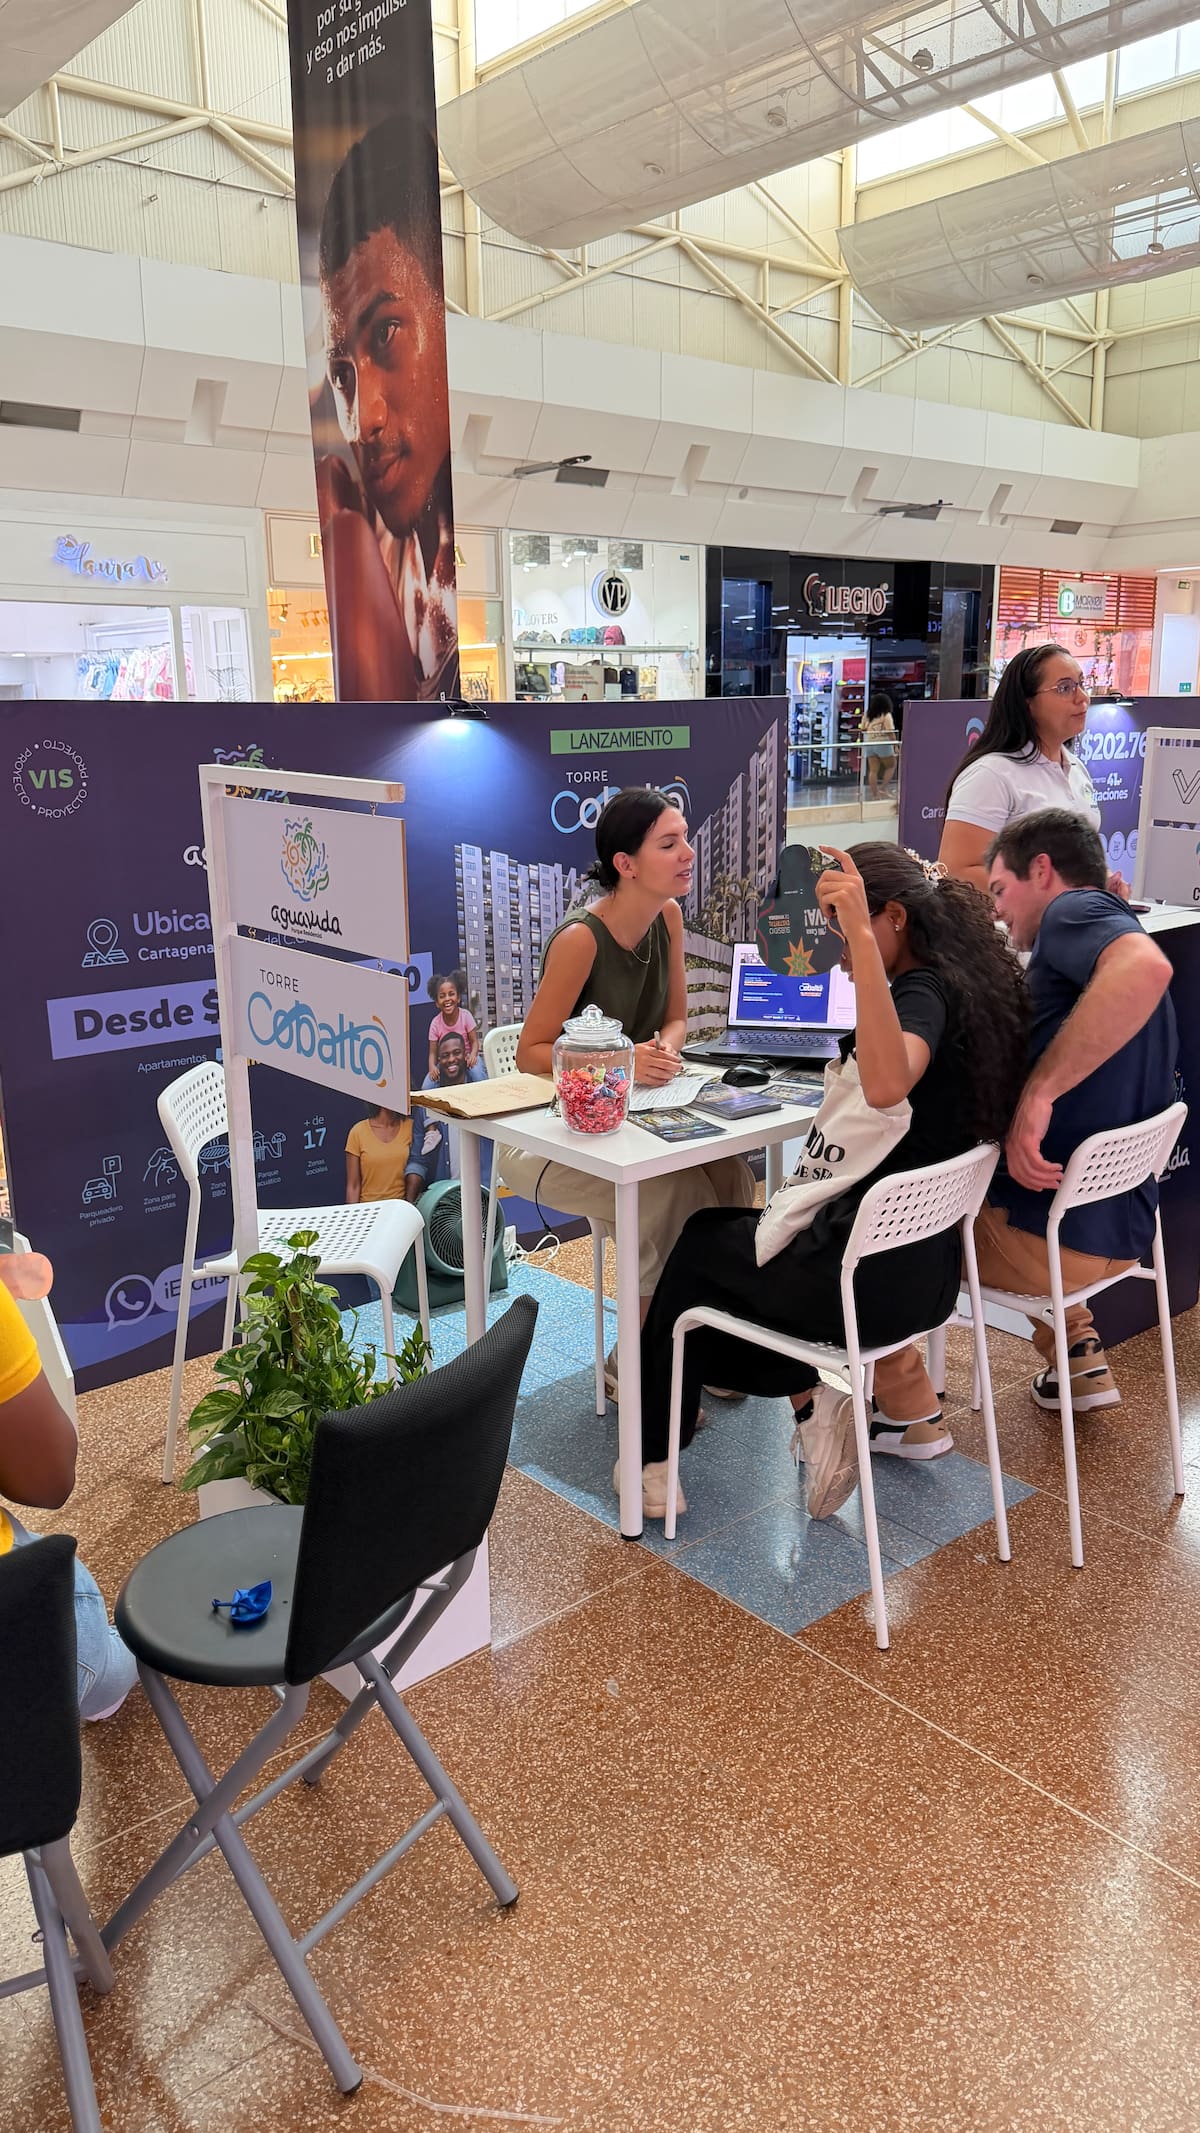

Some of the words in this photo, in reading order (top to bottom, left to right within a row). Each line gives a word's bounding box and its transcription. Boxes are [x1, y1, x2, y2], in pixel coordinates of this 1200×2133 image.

[317, 4, 336, 36] por
[306, 50, 313, 74] y
[314, 37, 334, 62] eso
[336, 21, 357, 49] nos
[326, 66, 334, 83] a
[336, 52, 355, 78] dar
[357, 34, 386, 65] más.
[605, 582, 627, 611] VP
[826, 585, 887, 616] LEGIO
[570, 729, 673, 750] LANZAMIENTO
[43, 740, 89, 779] PROYECTO
[13, 748, 33, 805] PROYECTO
[28, 768, 74, 789] VIS
[566, 770, 609, 784] TORRE
[37, 789, 88, 818] PROYECTO
[271, 904, 342, 936] aguavida
[138, 943, 215, 960] Cartagena
[259, 968, 299, 993] TORRE
[74, 998, 194, 1041] Desde
[248, 991, 389, 1081] Cobalto
[137, 1054, 207, 1073] Apartamentos
[312, 1115, 325, 1126] de
[304, 1127, 327, 1150] 17
[211, 1181, 226, 1190] Zona
[212, 1189, 226, 1198] BBQ
[144, 1196, 160, 1206] Zona
[161, 1193, 176, 1203] para
[145, 1202, 177, 1214] mascotas
[80, 1204, 123, 1220] Parqueadero
[89, 1215, 115, 1228] privado
